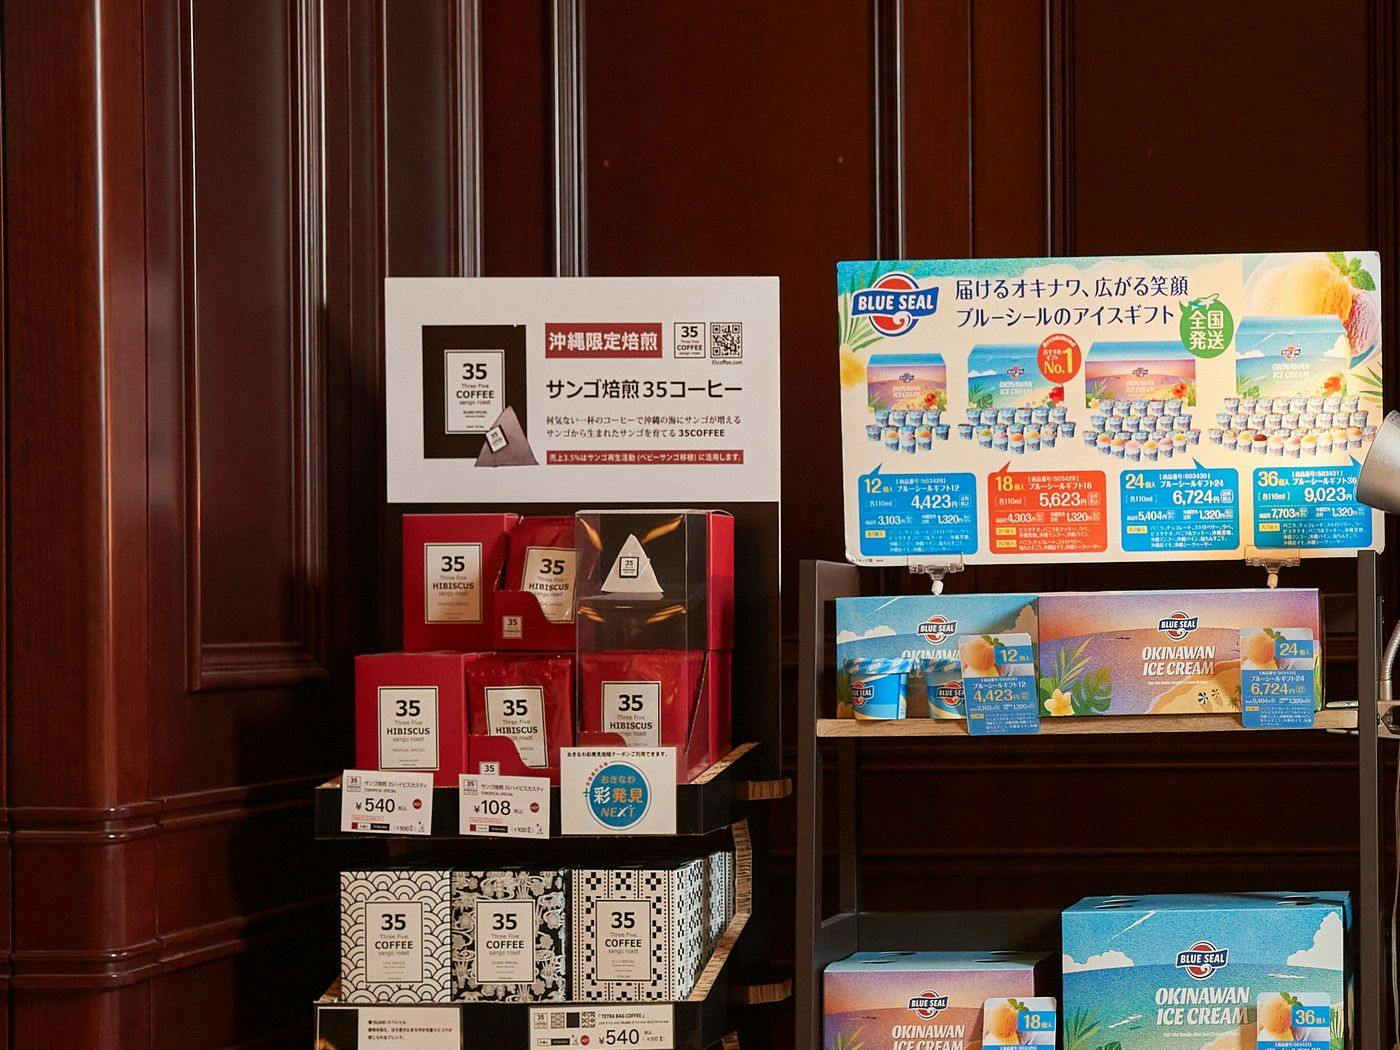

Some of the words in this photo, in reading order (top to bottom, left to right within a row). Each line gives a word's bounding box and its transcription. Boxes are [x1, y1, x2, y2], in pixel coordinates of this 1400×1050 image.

[956, 276, 1188, 300] 届けるオキナワ、広がる笑顔
[857, 295, 894, 311] BLUE
[898, 293, 934, 310] SEAL
[956, 304, 1174, 327] ブルーシールのアイスギフト
[1189, 309, 1224, 330] 全国
[681, 326, 698, 338] 35
[549, 332, 658, 351] 沖縄限定焙煎
[1189, 329, 1224, 351] 発送
[1043, 347, 1073, 375] No.1
[462, 363, 487, 380] 35
[456, 390, 494, 399] COFFEE
[547, 379, 742, 399] サンゴ焙煎35コーヒー
[679, 429, 725, 437] 35COFFEE
[1160, 480, 1224, 488] ブルーシールギフト24
[911, 494, 958, 509] 4,423円
[1039, 492, 1087, 507] 5,623円
[1173, 490, 1219, 505] 6,724円
[1304, 488, 1352, 502] 9,023円
[441, 556, 465, 572] 35
[540, 559, 565, 575] 35
[920, 624, 937, 633] BLUE
[939, 622, 954, 632] SEAL
[1160, 620, 1178, 630] BLUE
[1180, 619, 1197, 629] SEAL
[1142, 645, 1215, 662] OKINAWAN
[1142, 661, 1164, 676] ICE
[1167, 661, 1214, 676] CREAM
[974, 690, 1019, 702] 4,423円
[1251, 683, 1295, 695] 6,724円
[395, 700, 420, 716] 35
[503, 699, 527, 716] 35
[618, 695, 643, 711] 35
[387, 727, 430, 735] HIBISCUS
[496, 726, 538, 734] HIBISCUS
[600, 775, 635, 785] おきなわ
[593, 788, 643, 805] 彩発見
[355, 797, 395, 812] ¥540
[474, 799, 510, 815] ¥108
[601, 805, 635, 818] NEXT
[380, 914, 406, 930] 35
[492, 914, 517, 930] 35
[611, 912, 635, 928] 35
[374, 940, 413, 950] COFFEE
[486, 940, 524, 949] COFFEE
[605, 938, 642, 948] COFFEE
[1180, 955, 1201, 966] BLUE
[1203, 952, 1225, 964] SEAL
[911, 998, 928, 1009] BLUE
[930, 997, 946, 1007] SEAL
[1156, 988, 1250, 1006] OKINAWAN
[1156, 1007, 1184, 1025] ICE
[1187, 1006, 1249, 1025] CREAM
[599, 1029, 640, 1045] ¥540
[891, 1025, 965, 1040] OKINAWAN
